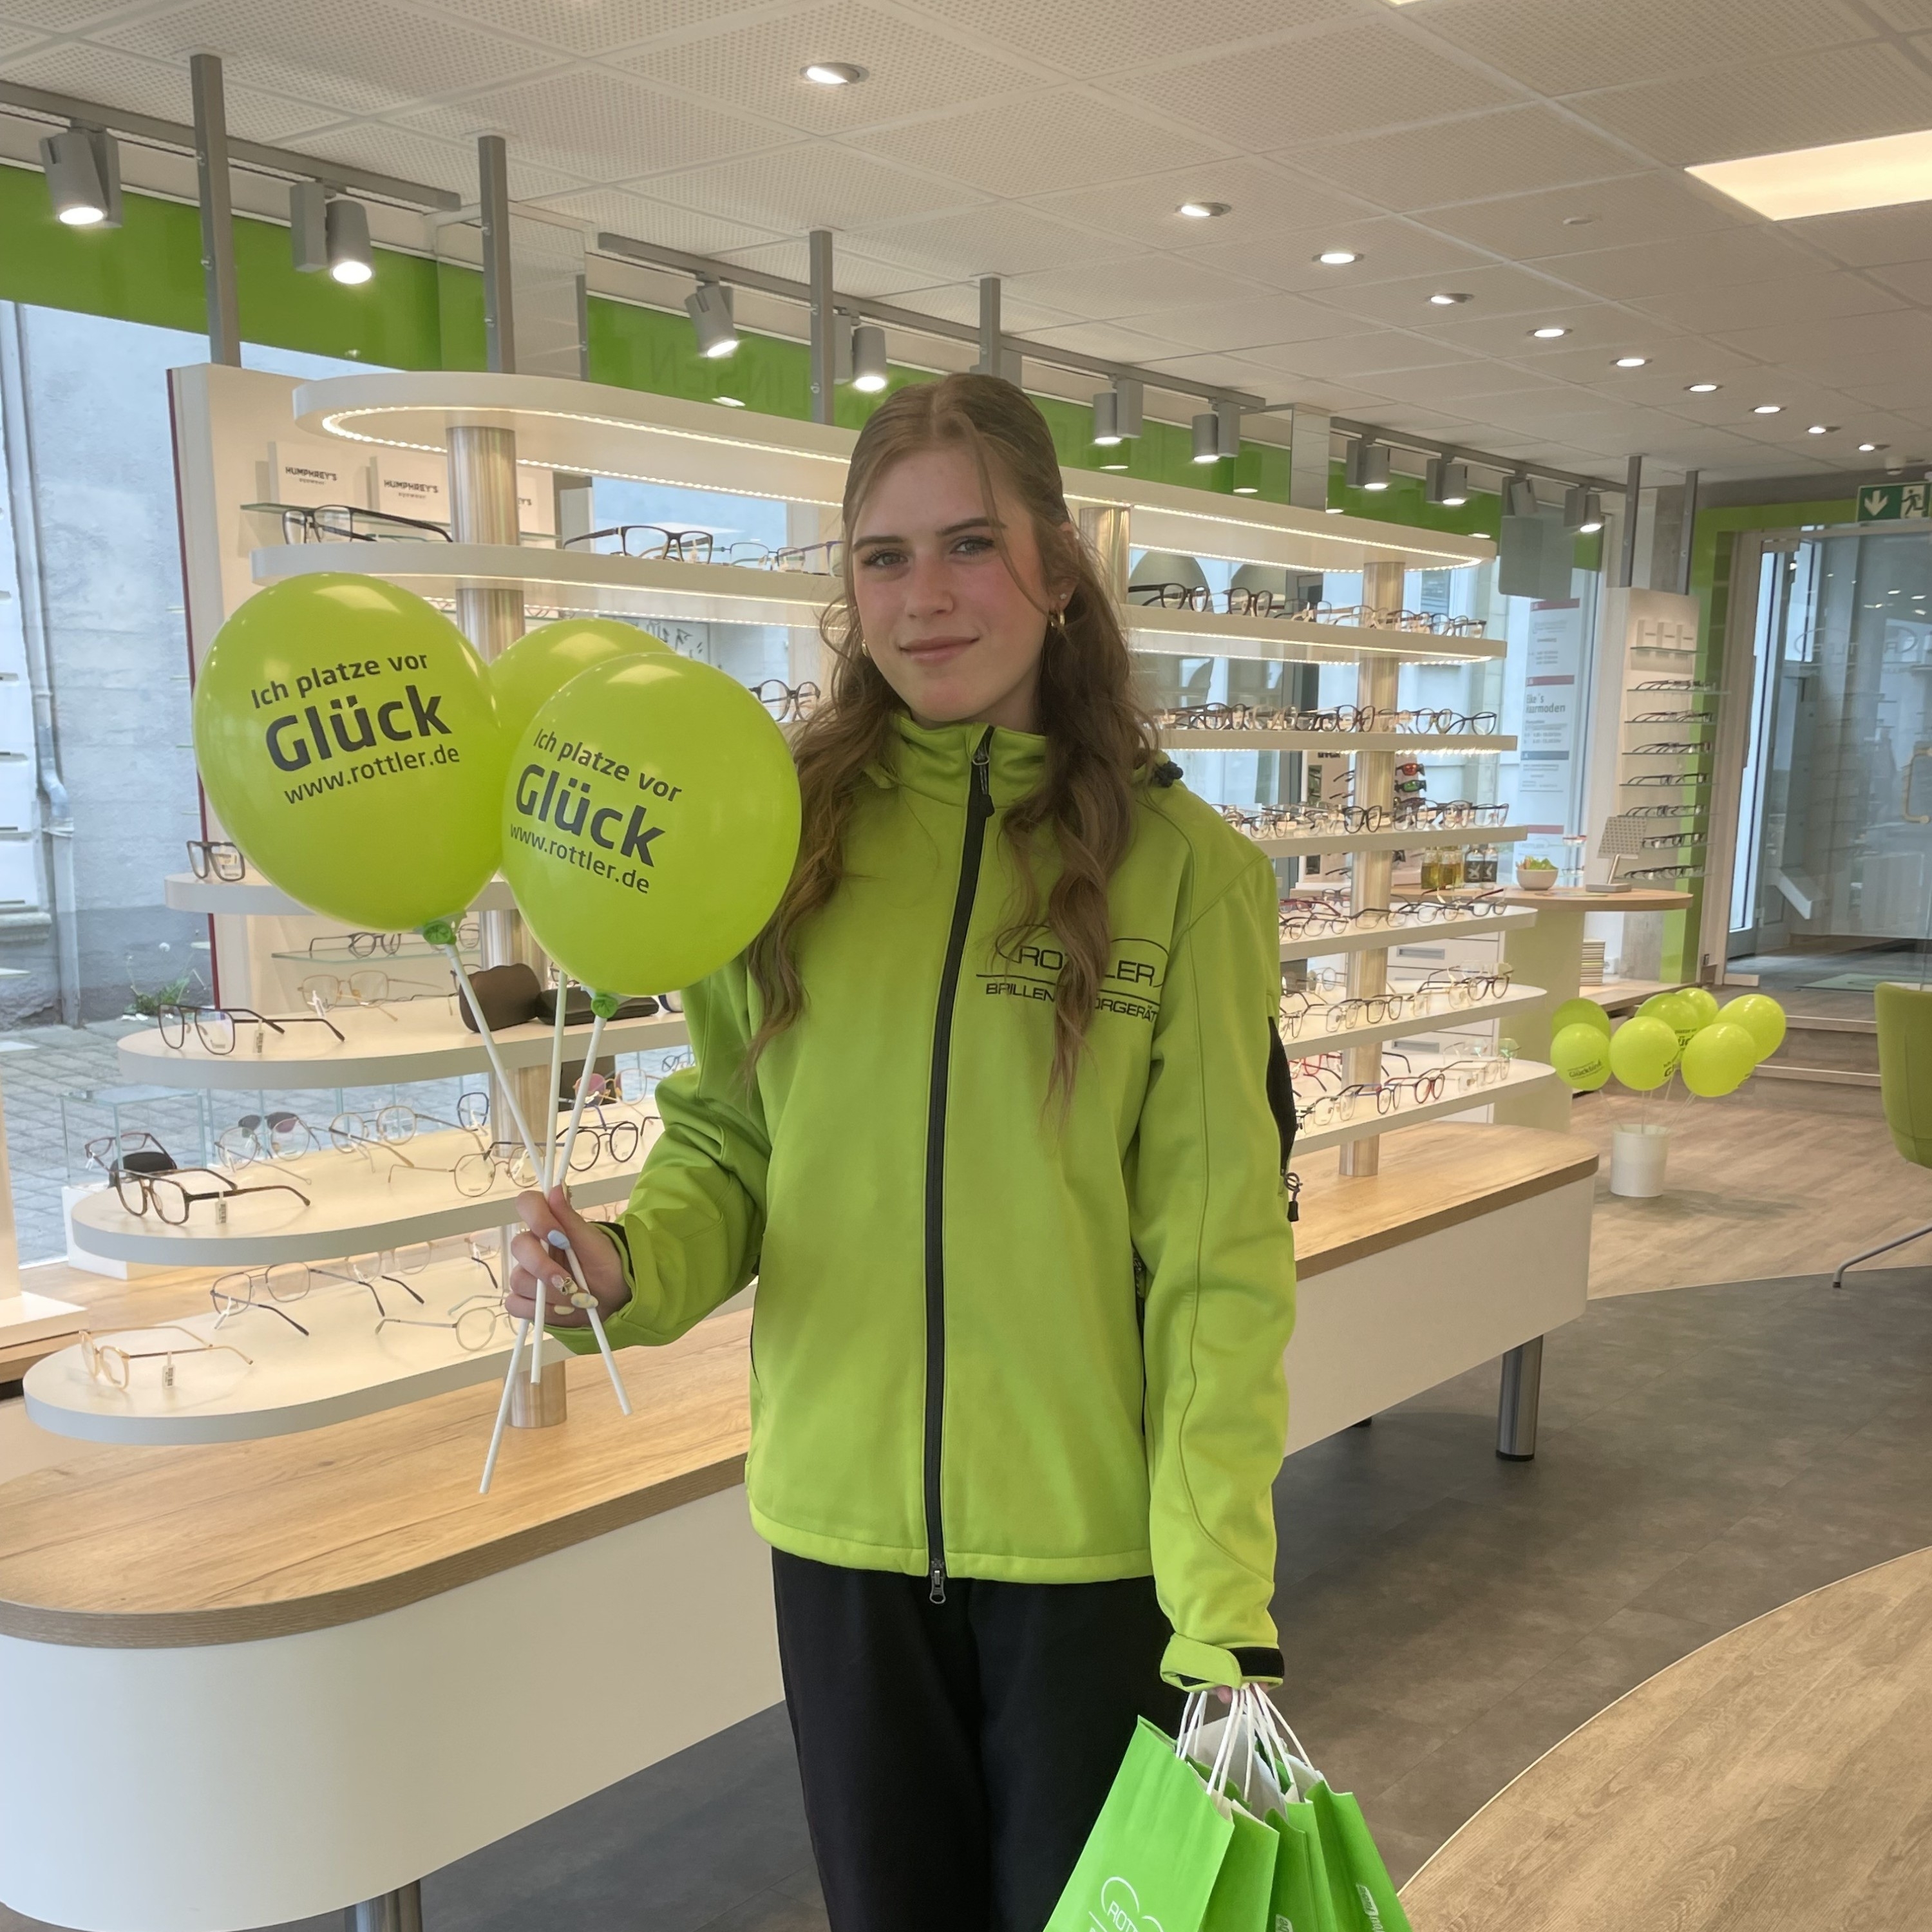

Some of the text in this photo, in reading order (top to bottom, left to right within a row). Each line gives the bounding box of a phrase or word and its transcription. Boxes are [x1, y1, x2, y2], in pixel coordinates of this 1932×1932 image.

[285, 466, 337, 481] HUMPHREY'S
[384, 479, 439, 493] HUMPHREY'S
[251, 654, 428, 709] Ich platze vor
[265, 685, 453, 772] Glück
[284, 744, 460, 805] www.rottler.de
[533, 728, 683, 802] Ich platze vor
[516, 763, 666, 868] Glück
[510, 823, 650, 895] www.rottler.de
[985, 982, 1056, 1003] BRILLEN
[1018, 945, 1155, 987] ROER
